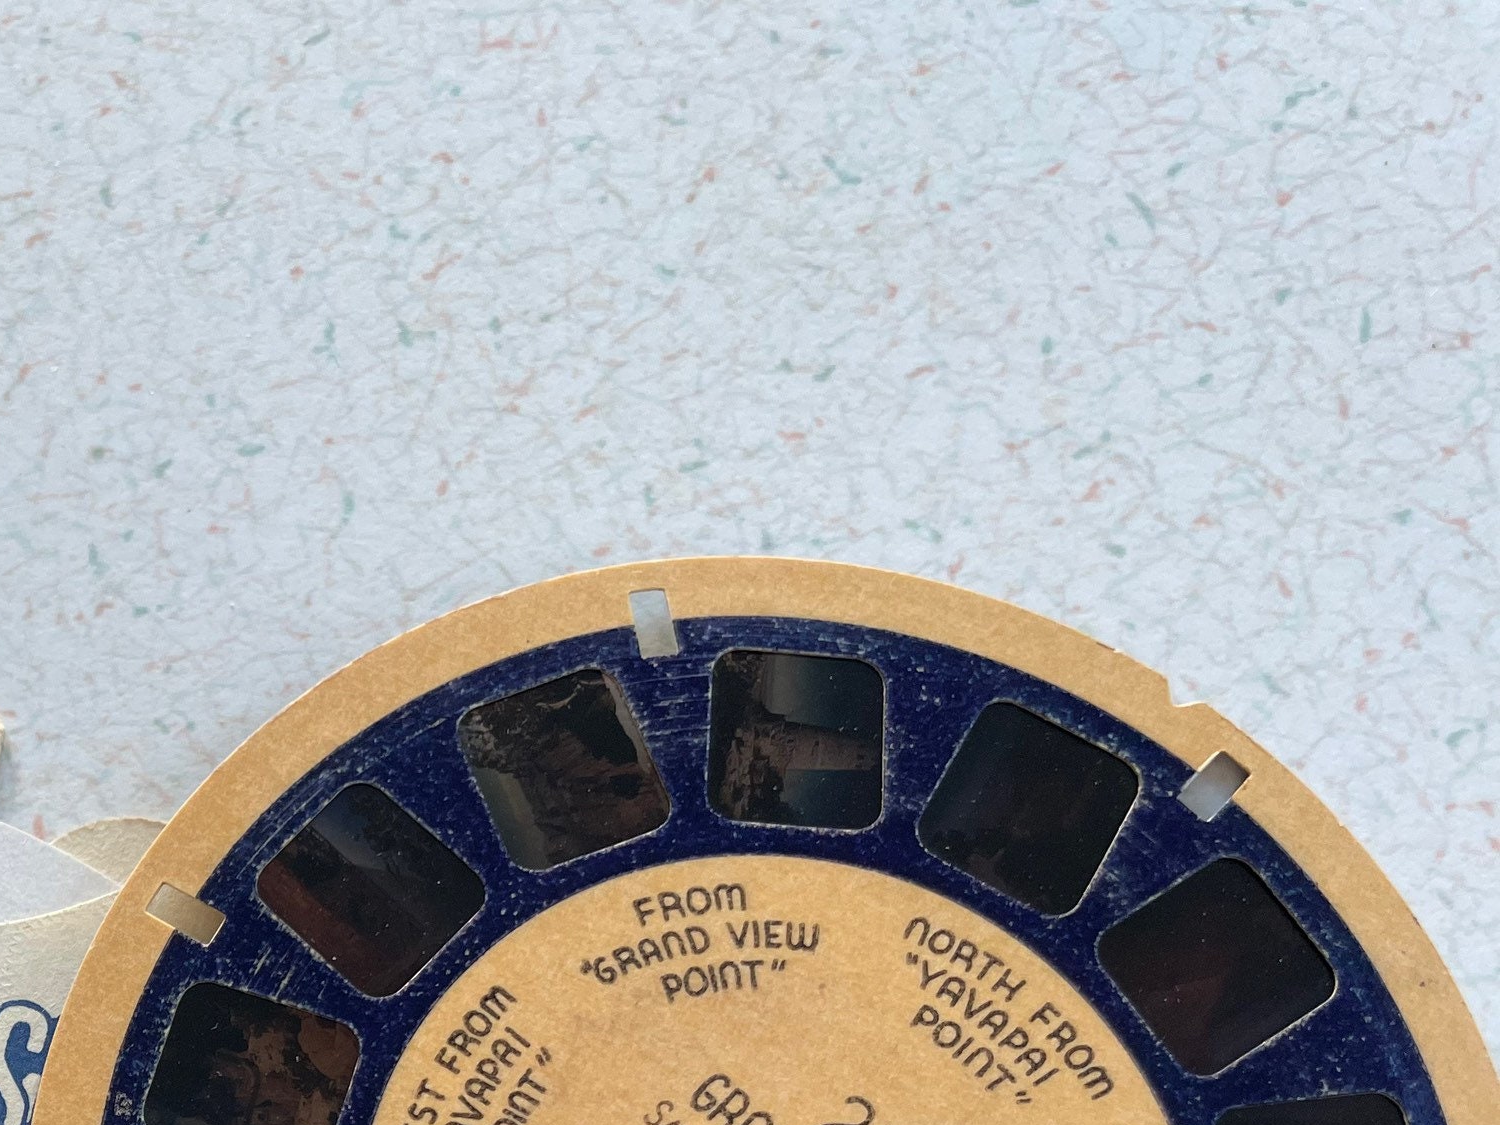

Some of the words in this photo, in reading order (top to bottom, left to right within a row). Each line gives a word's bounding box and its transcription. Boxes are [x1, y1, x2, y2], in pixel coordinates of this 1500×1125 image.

[633, 883, 747, 926] FROM
[726, 920, 820, 953] VIEW
[434, 985, 517, 1074] FROM
[903, 917, 1027, 1002] NORTH
[1029, 1002, 1114, 1100] FROM
